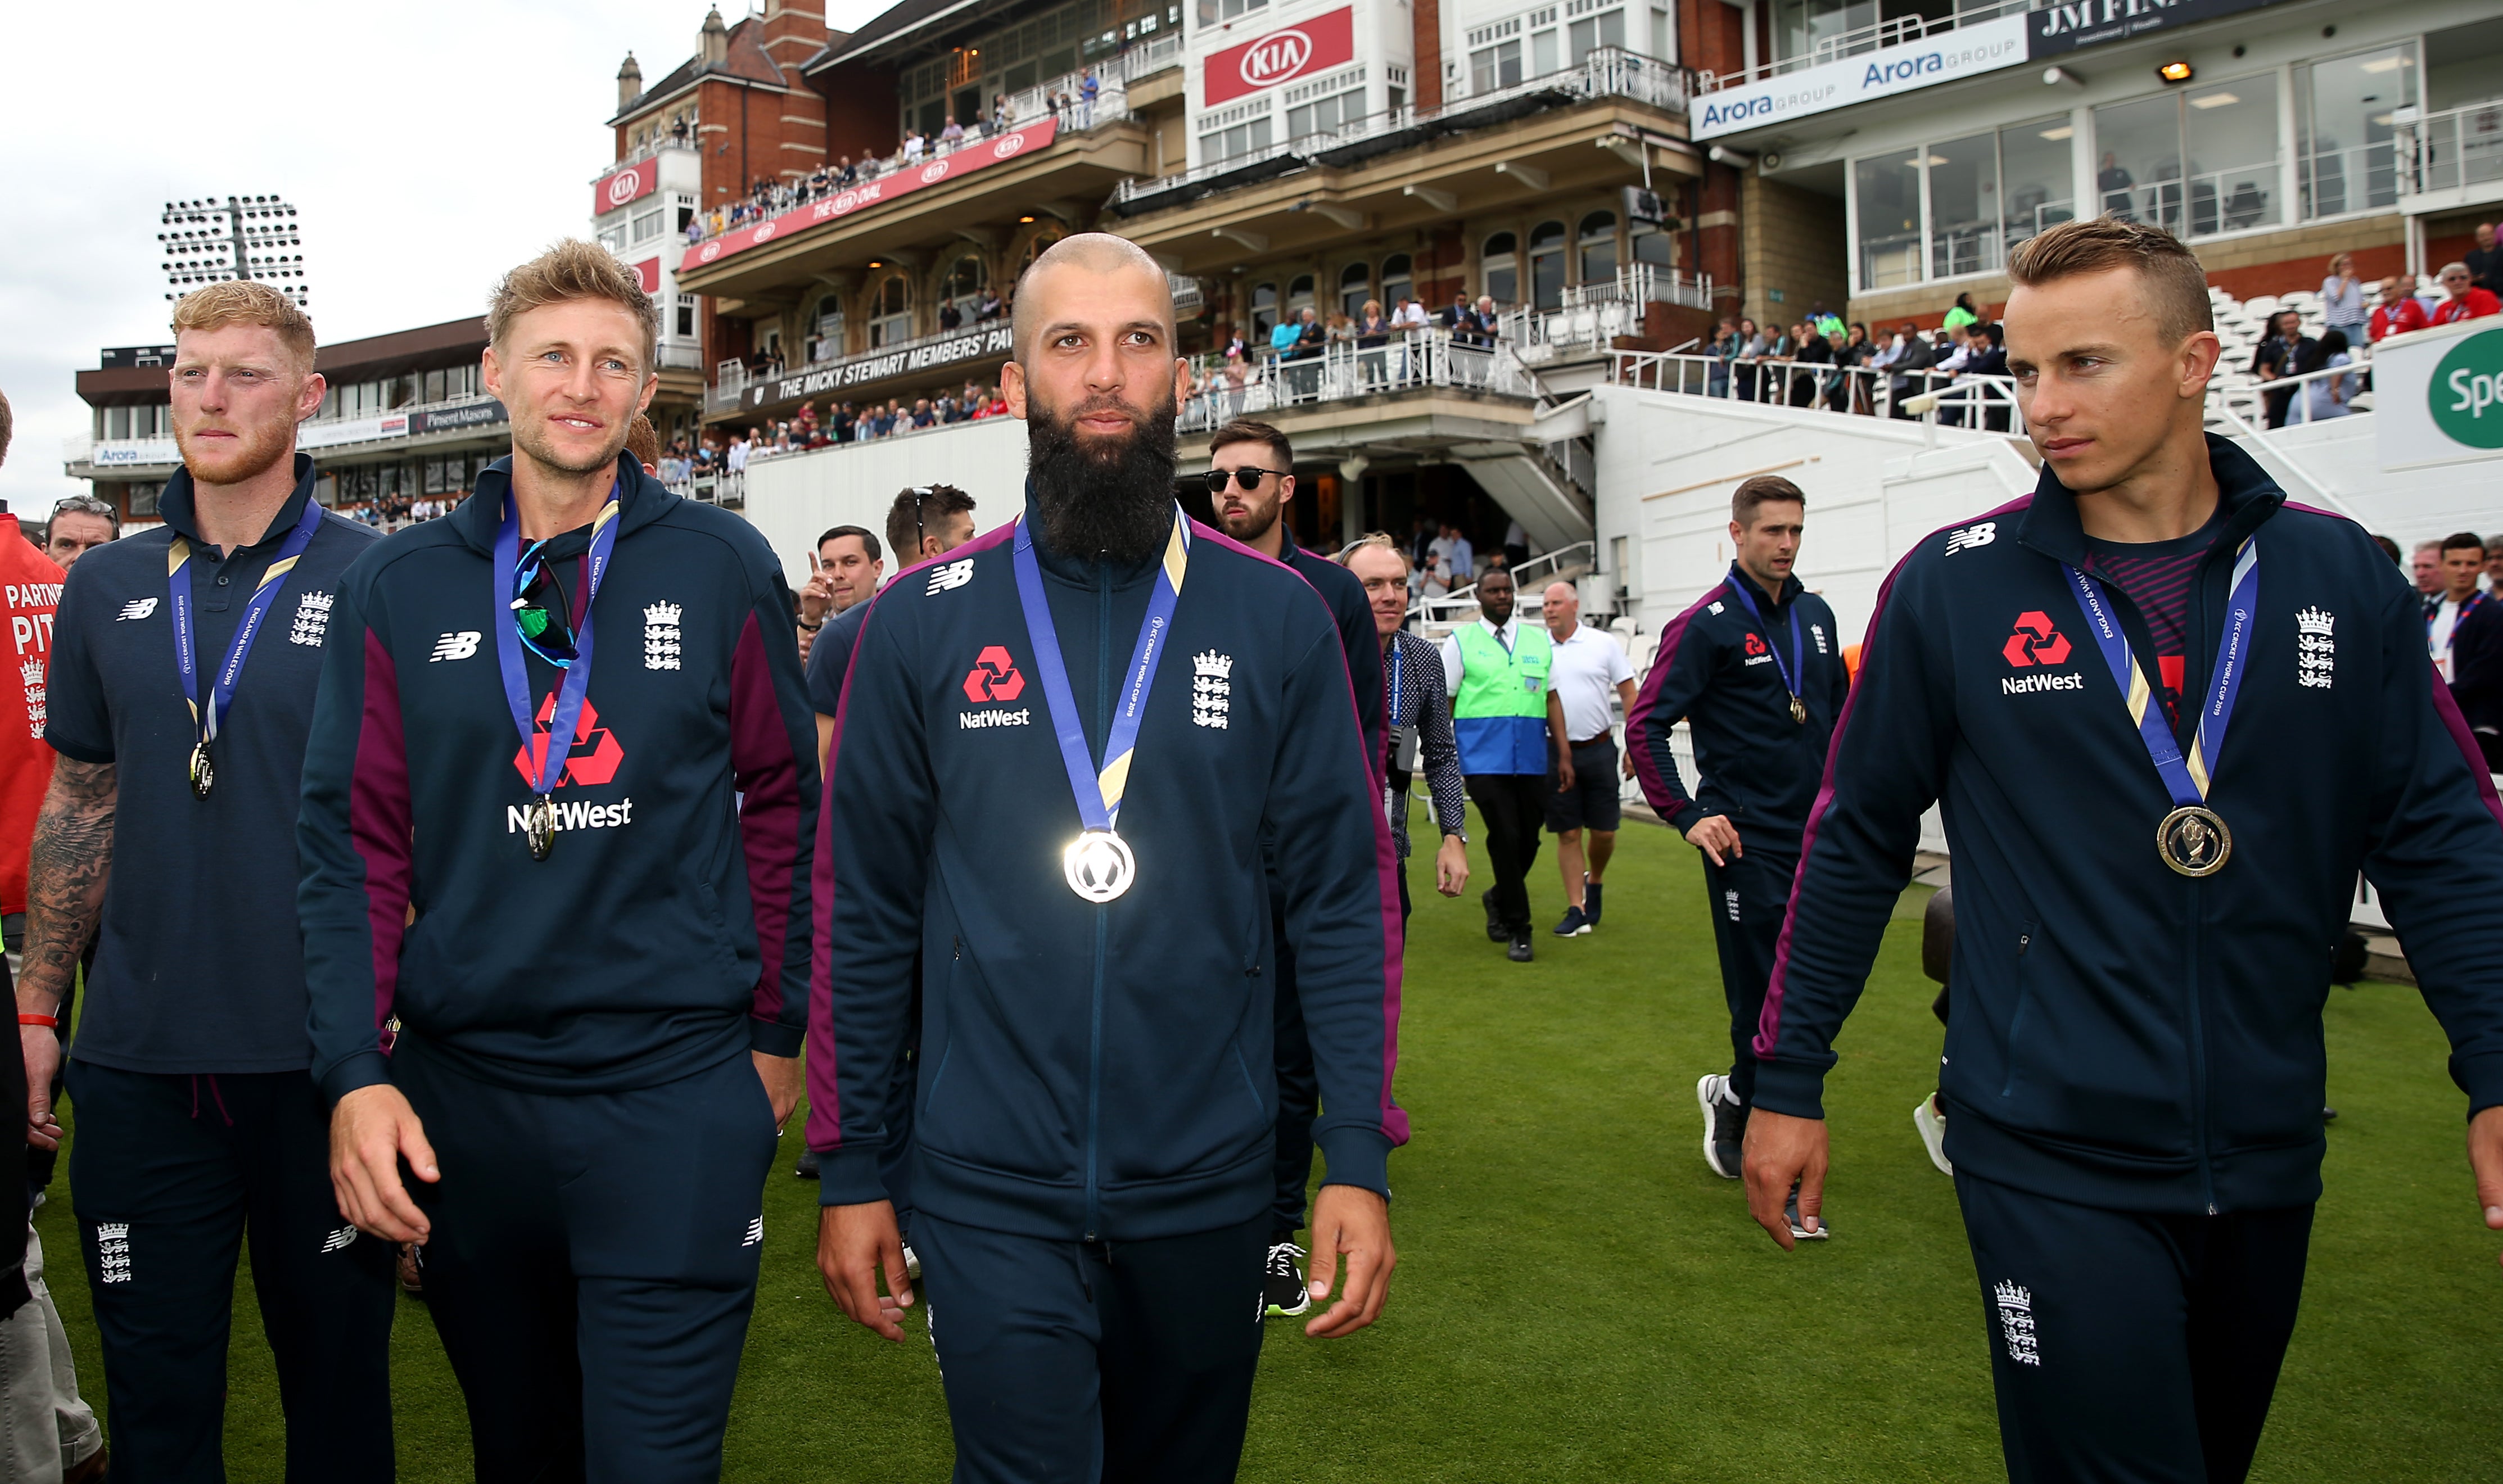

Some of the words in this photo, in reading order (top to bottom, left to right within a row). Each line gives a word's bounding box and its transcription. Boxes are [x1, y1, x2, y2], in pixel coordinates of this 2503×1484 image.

[1252, 38, 1300, 79] KIA
[1862, 51, 1942, 89] Arora
[1944, 39, 2017, 69] GROUP
[1702, 95, 1772, 128] Arora
[1774, 84, 1836, 111] GROUP
[813, 202, 833, 220] THE
[857, 183, 881, 204] OVAL
[779, 378, 802, 400] THE
[804, 366, 844, 394] MICKY
[844, 352, 907, 384] STEWART
[102, 449, 137, 461] Arora
[242, 607, 261, 639] ENGLAND
[2089, 599, 2113, 639] ENGLAND
[1150, 628, 1158, 639] ICC
[229, 645, 244, 669] WALES
[1142, 639, 1154, 664] CRICKET
[2229, 632, 2239, 660] CRICKET
[224, 668, 235, 685] 2019
[1135, 665, 1147, 688] WORLD
[2002, 672, 2084, 695] NatWest
[2222, 661, 2233, 686] WORLD
[1131, 688, 1140, 703] CUP
[2218, 685, 2226, 700] CUP
[960, 708, 1030, 729] NatWest
[1126, 702, 1136, 717] 2019
[2213, 700, 2222, 716] 2019
[508, 797, 632, 833] NtWest
